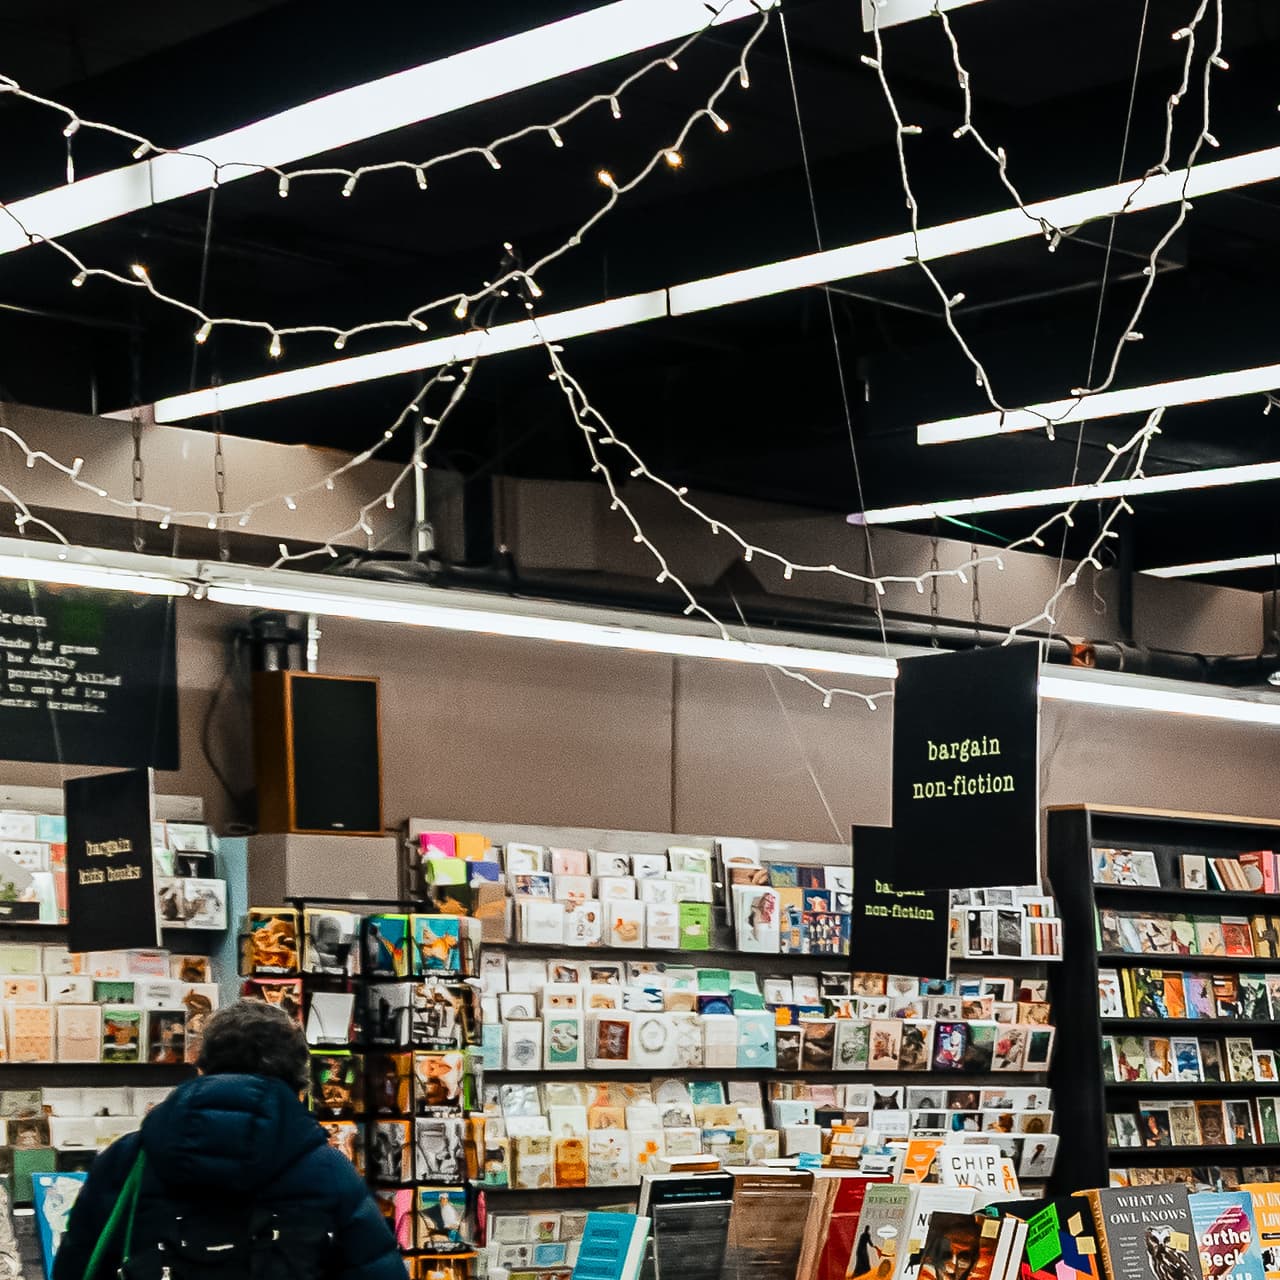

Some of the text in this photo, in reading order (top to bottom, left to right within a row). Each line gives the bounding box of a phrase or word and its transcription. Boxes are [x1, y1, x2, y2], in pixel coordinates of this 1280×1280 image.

[927, 735, 1001, 763] bargain
[913, 772, 1015, 799] non-fiction
[865, 904, 935, 921] non-fiction
[951, 1156, 996, 1171] CHIP
[954, 1170, 997, 1187] WAR
[1116, 1193, 1176, 1208] WHAT AN
[1110, 1208, 1187, 1225] OWL KNOWS
